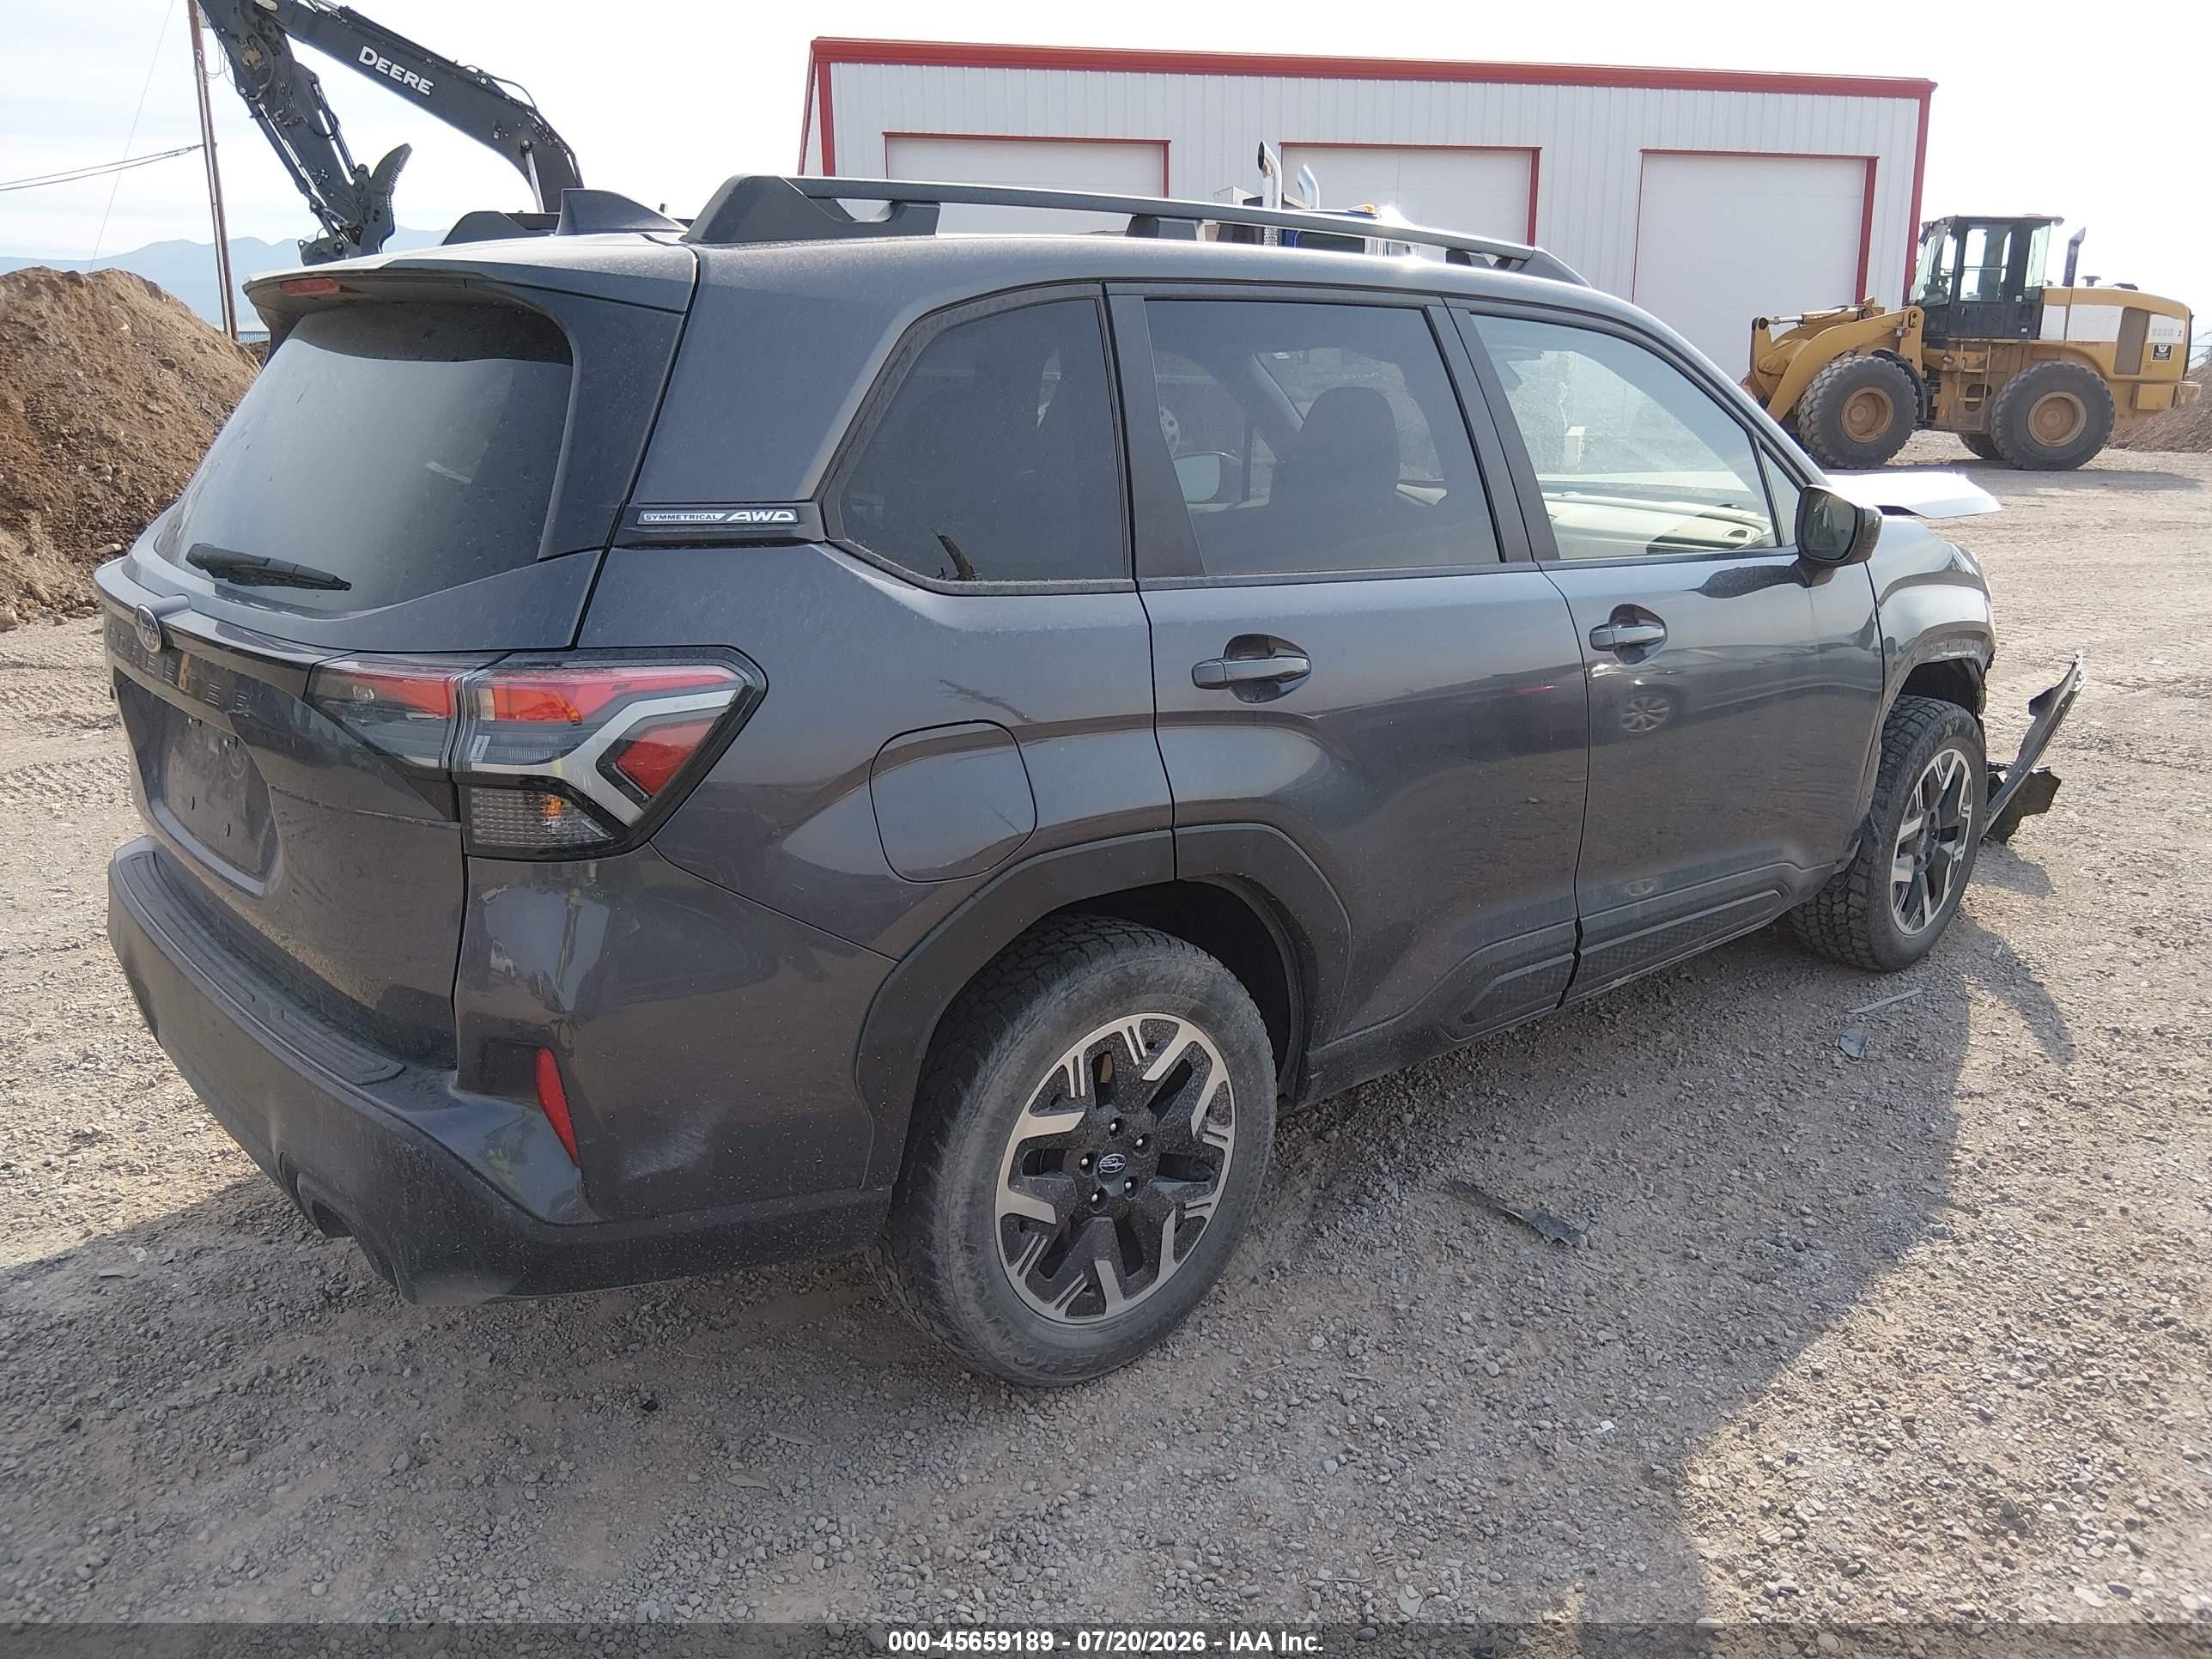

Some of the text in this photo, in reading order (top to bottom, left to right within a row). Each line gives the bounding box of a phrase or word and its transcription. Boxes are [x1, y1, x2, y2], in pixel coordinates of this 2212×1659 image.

[358, 46, 434, 96] DEERE
[726, 511, 795, 522] AWD
[109, 623, 249, 718] FORESER
